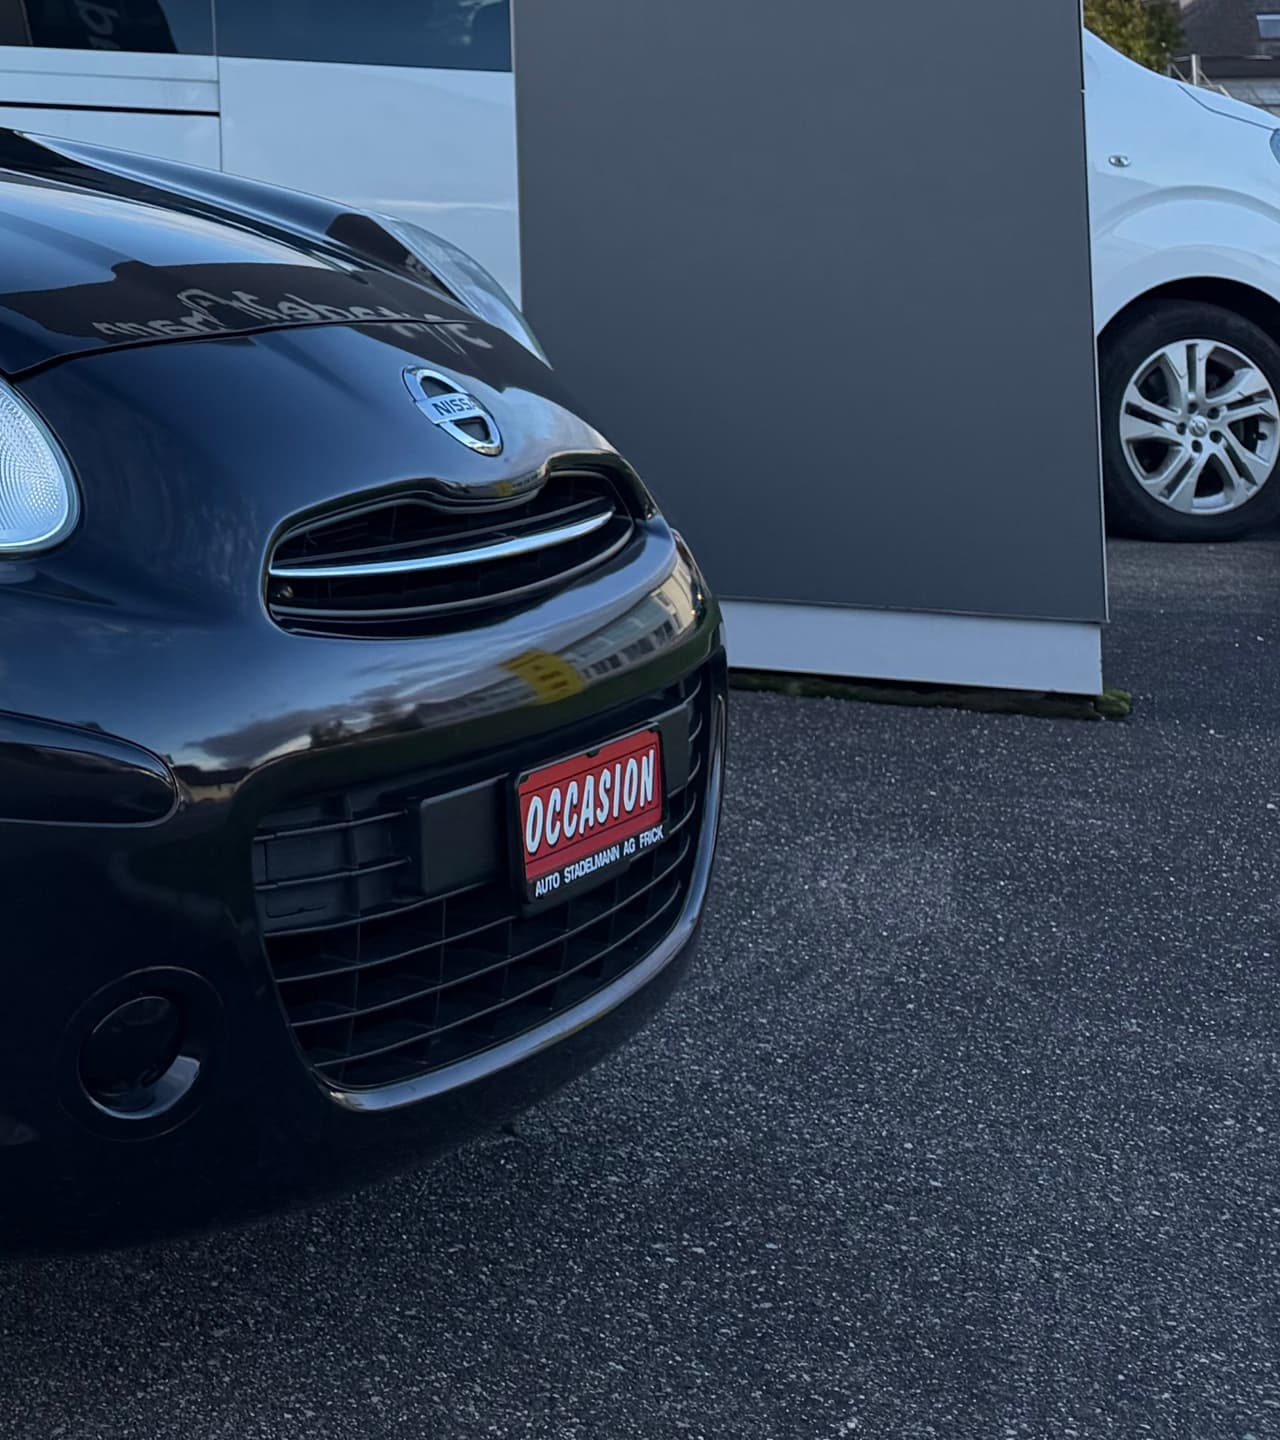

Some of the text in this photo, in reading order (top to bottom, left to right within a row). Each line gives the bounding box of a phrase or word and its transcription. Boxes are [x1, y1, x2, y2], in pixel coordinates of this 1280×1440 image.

[526, 749, 654, 853] OCCASION
[535, 824, 664, 897] AUTO STADELMANN AG FRICK
